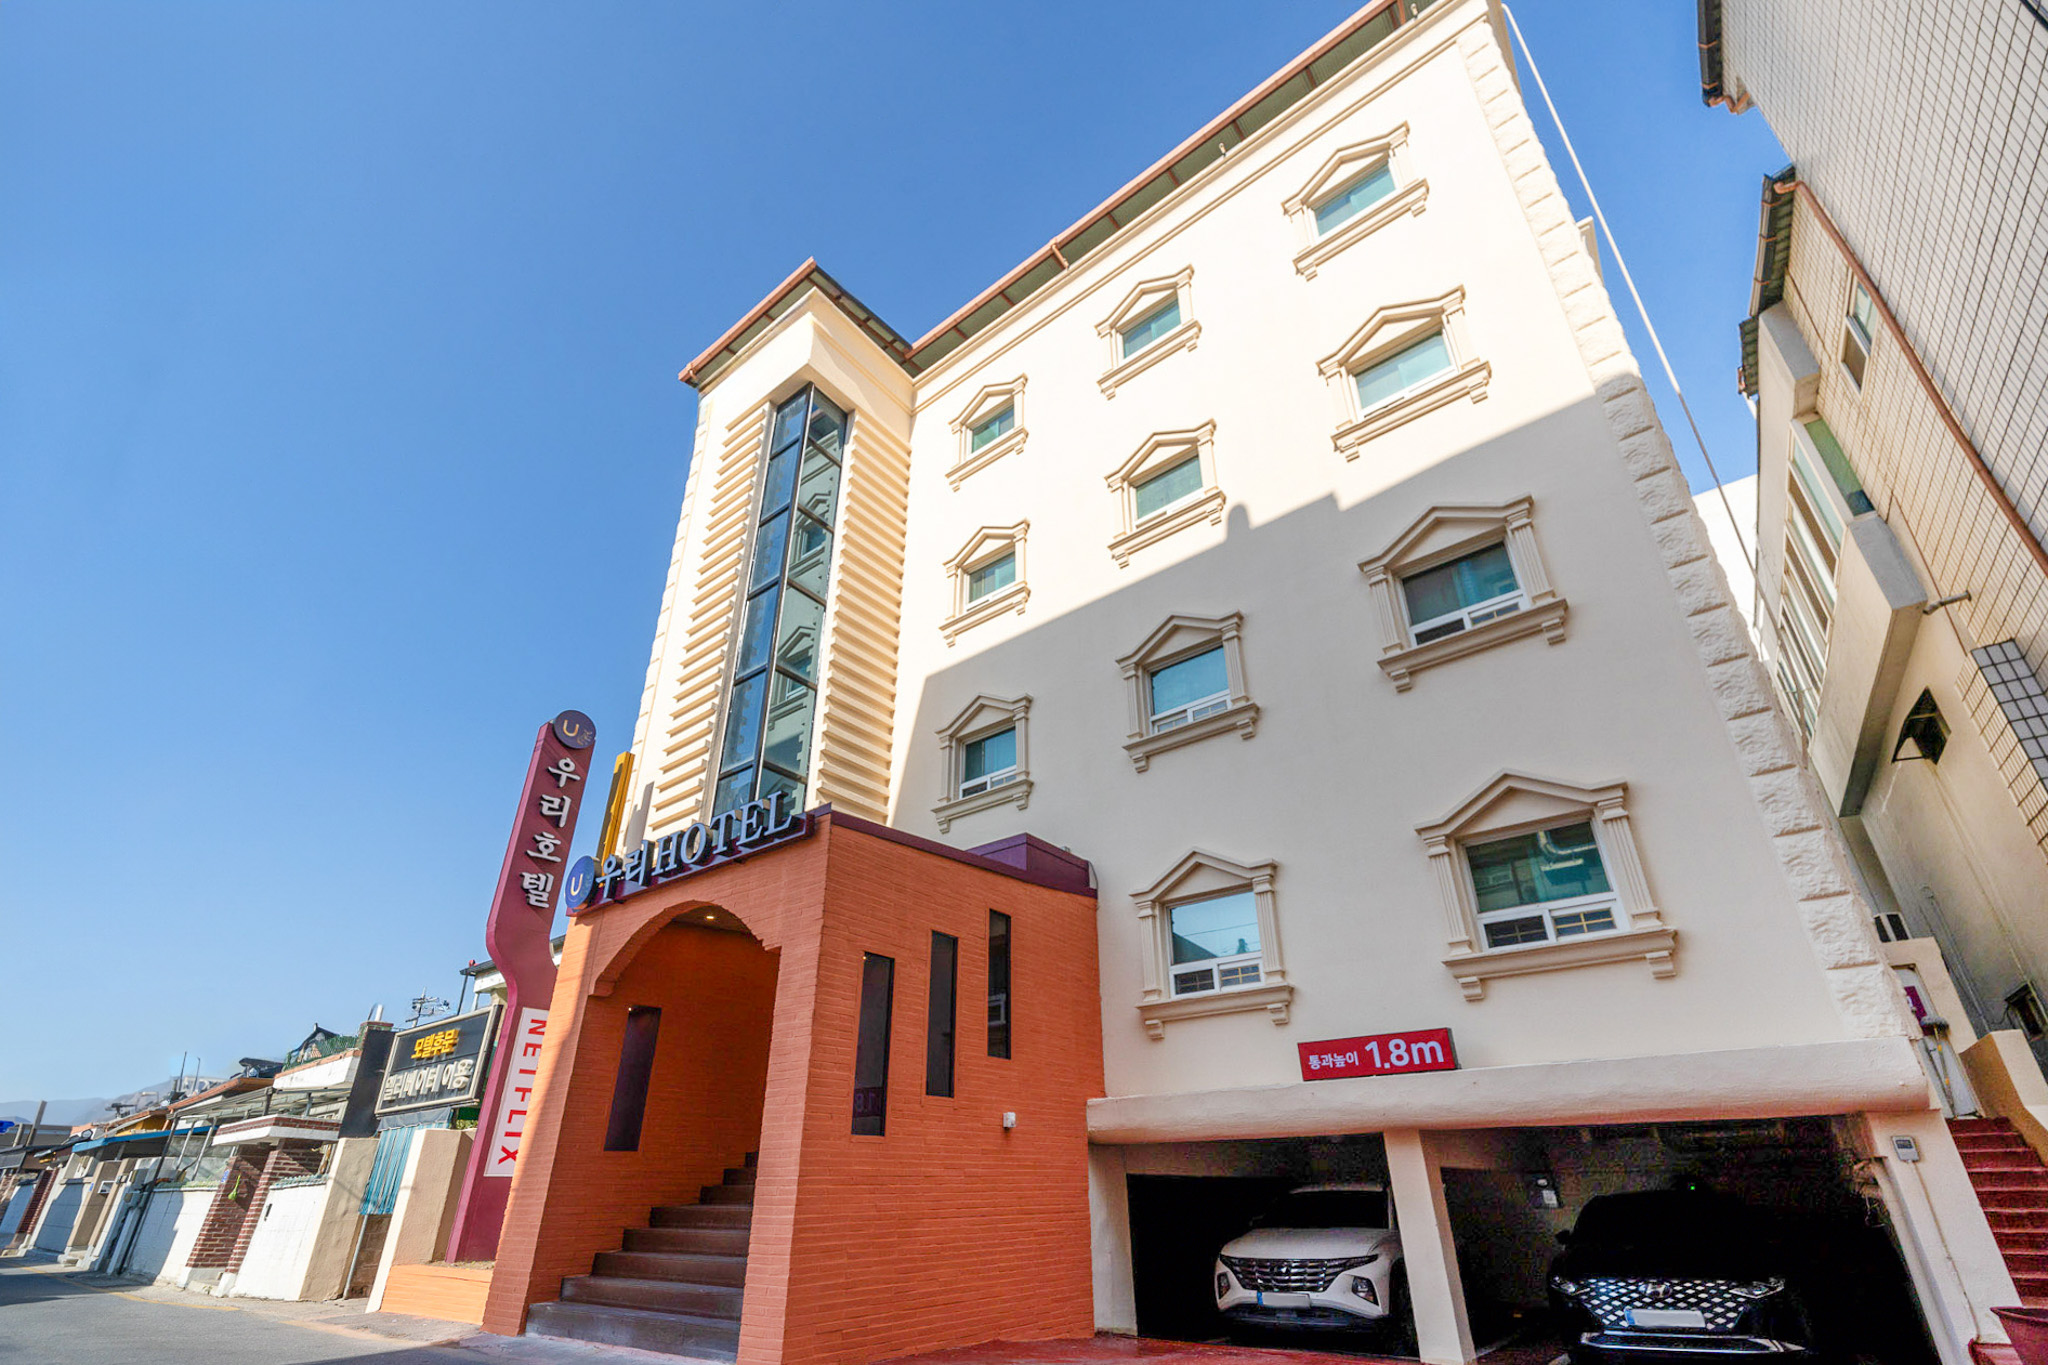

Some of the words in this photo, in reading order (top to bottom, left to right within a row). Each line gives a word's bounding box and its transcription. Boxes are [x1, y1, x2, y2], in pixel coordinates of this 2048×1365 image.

[520, 757, 581, 909] 우리호텔
[411, 1029, 459, 1060] 모텔후문
[1308, 1051, 1359, 1070] 통과높이
[1364, 1038, 1444, 1069] 1.8m
[383, 1063, 446, 1102] 엘리베이터
[441, 1059, 475, 1091] 이용
